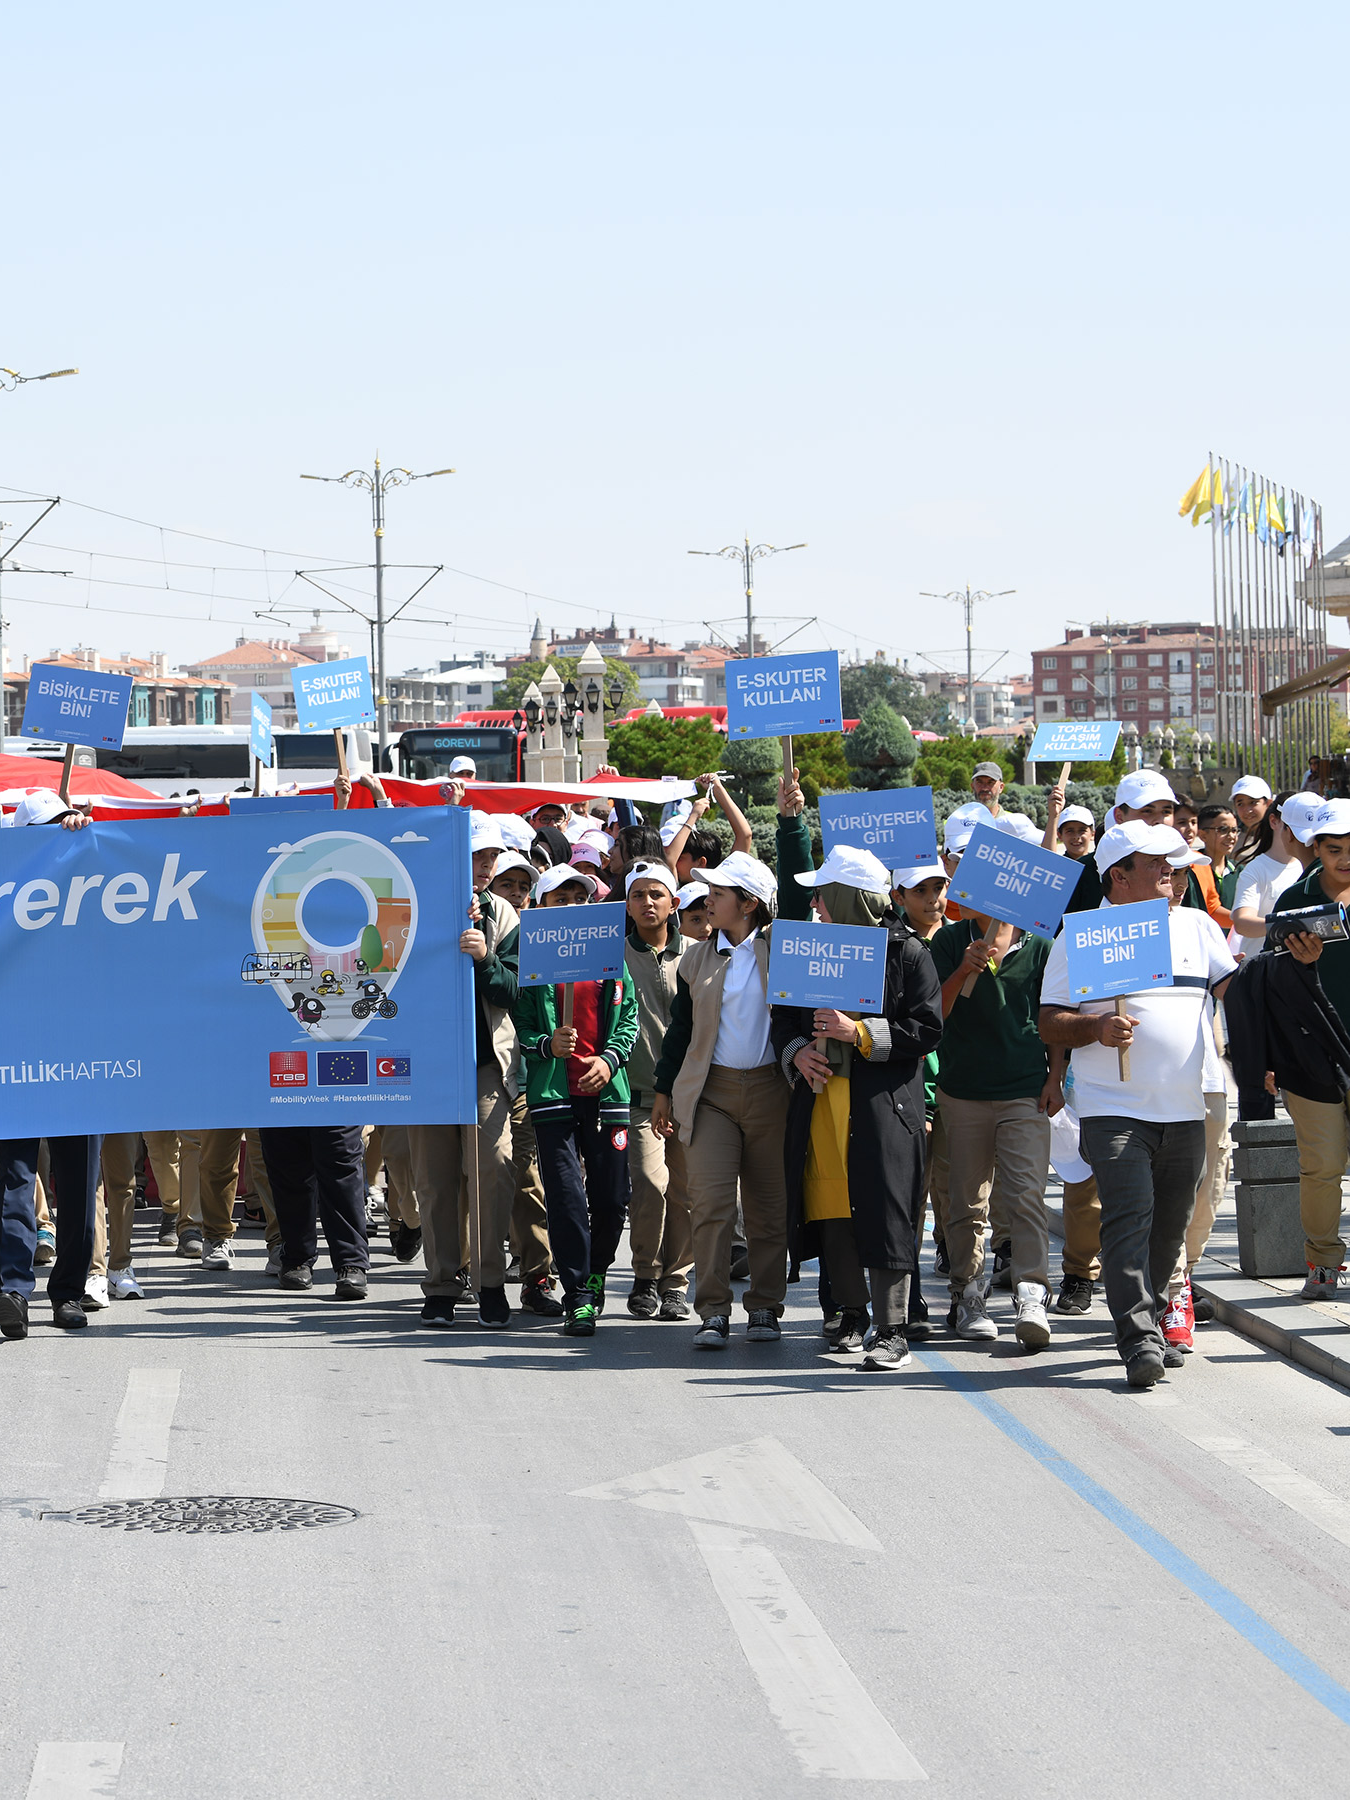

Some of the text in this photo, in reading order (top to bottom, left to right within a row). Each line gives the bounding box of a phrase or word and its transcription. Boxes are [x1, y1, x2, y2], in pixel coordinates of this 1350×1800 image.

[300, 670, 363, 692] E-SKUTER
[736, 667, 827, 690] E-SKUTER
[38, 680, 120, 705] BİSİKLETE
[307, 686, 361, 707] KULLAN!
[742, 687, 822, 707] KULLAN!
[59, 700, 92, 718] BİN!
[1051, 734, 1101, 743] ULAŞIM
[1057, 725, 1101, 733] TOPLU
[434, 738, 481, 748] GÖREVLİ
[1044, 742, 1102, 750] KULLAN!
[827, 810, 928, 831] YÜRÜYEREK
[863, 829, 895, 845] GİT!
[975, 843, 1066, 891] BİSİKLETE
[993, 871, 1032, 897] BİN!
[525, 924, 619, 945] YÜRÜYEREK
[1075, 920, 1160, 951] BİSİKLETE
[557, 941, 586, 958] GİT!
[781, 937, 875, 963] BİSİKLETE
[1102, 941, 1135, 965] BİN!
[808, 960, 844, 979] BİN!
[270, 1093, 412, 1104] #MobilityWeek #HareketlilikHaftası
